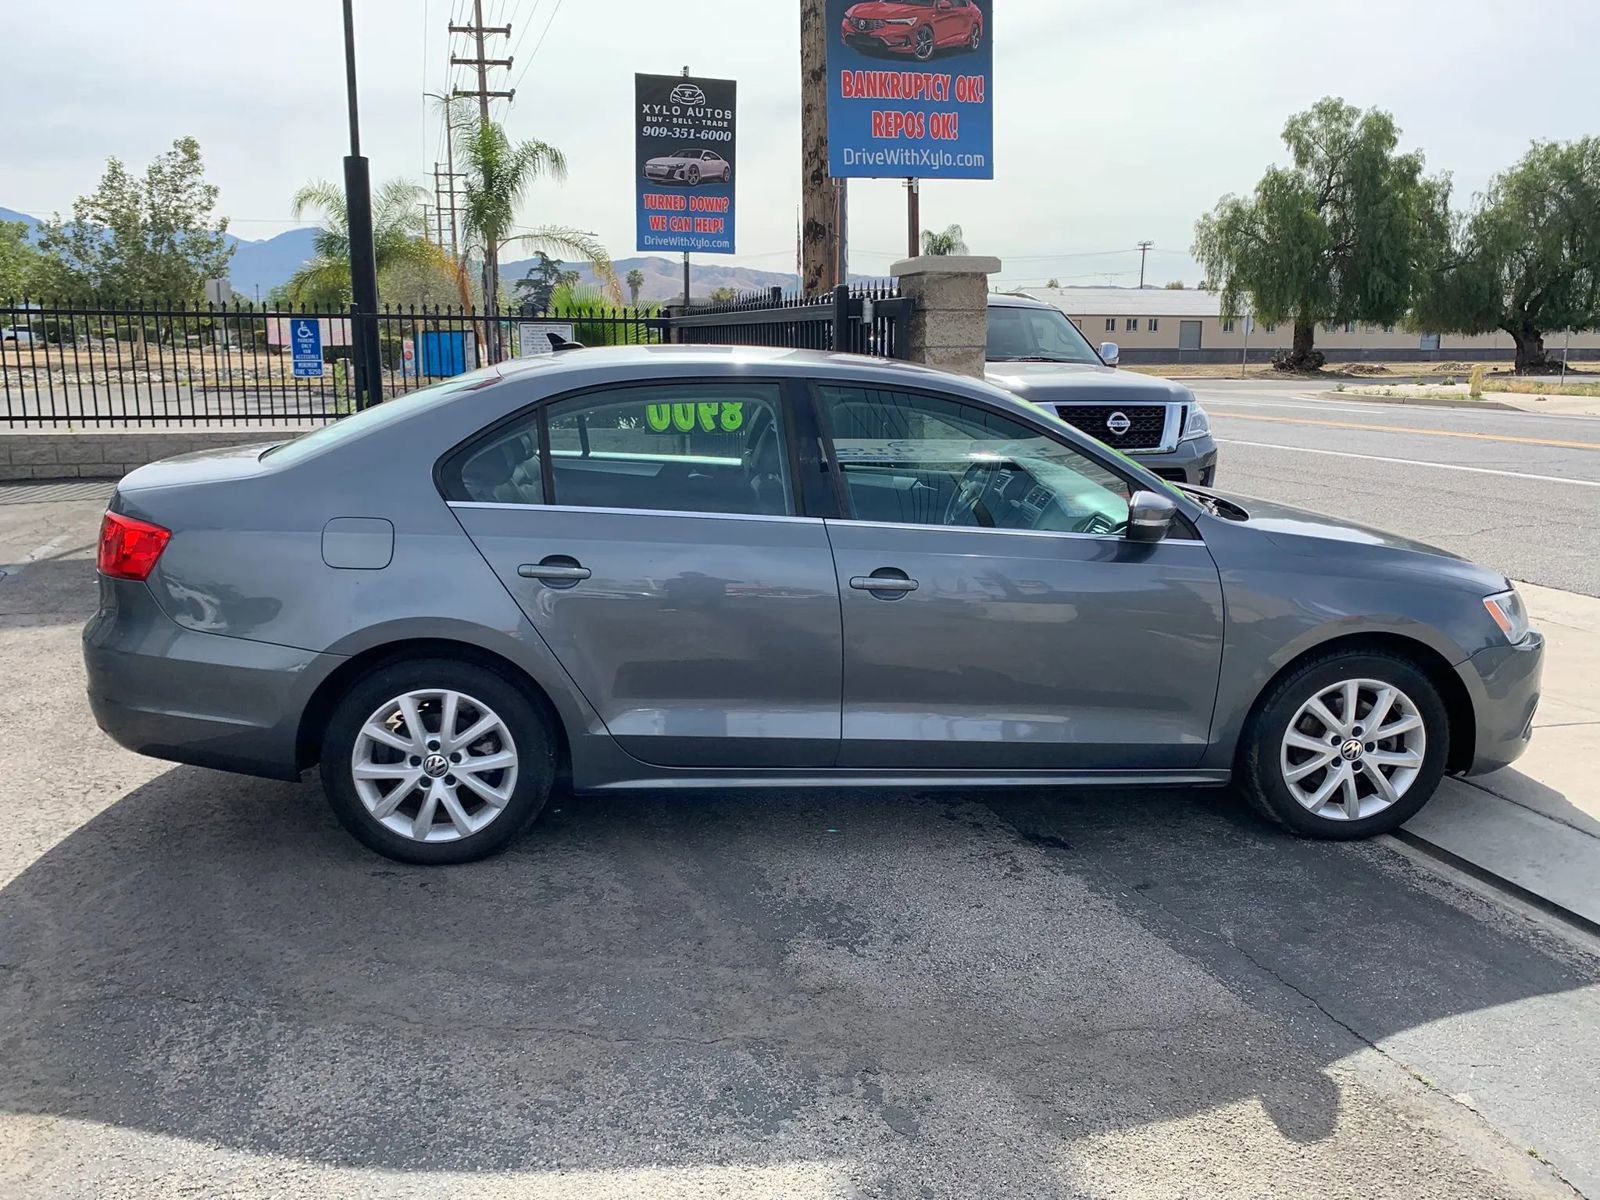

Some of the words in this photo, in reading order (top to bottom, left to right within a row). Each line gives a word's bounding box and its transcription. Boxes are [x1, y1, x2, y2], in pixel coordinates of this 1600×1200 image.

[841, 70, 951, 101] BANKRUPTCY
[955, 75, 984, 103] OK!
[642, 104, 680, 115] XYLO
[687, 107, 732, 119] AUTOS
[642, 126, 732, 141] 909-351-6000
[872, 111, 925, 139] REPOS
[929, 112, 959, 141] OK!
[844, 148, 985, 170] DriveWithXylo.com
[643, 193, 686, 211] TURNED
[689, 195, 729, 213] DOWN?
[649, 215, 667, 231] WE
[670, 216, 692, 232] CAN
[694, 217, 724, 233] HELP!
[644, 235, 730, 249] DriveWithXylo.com
